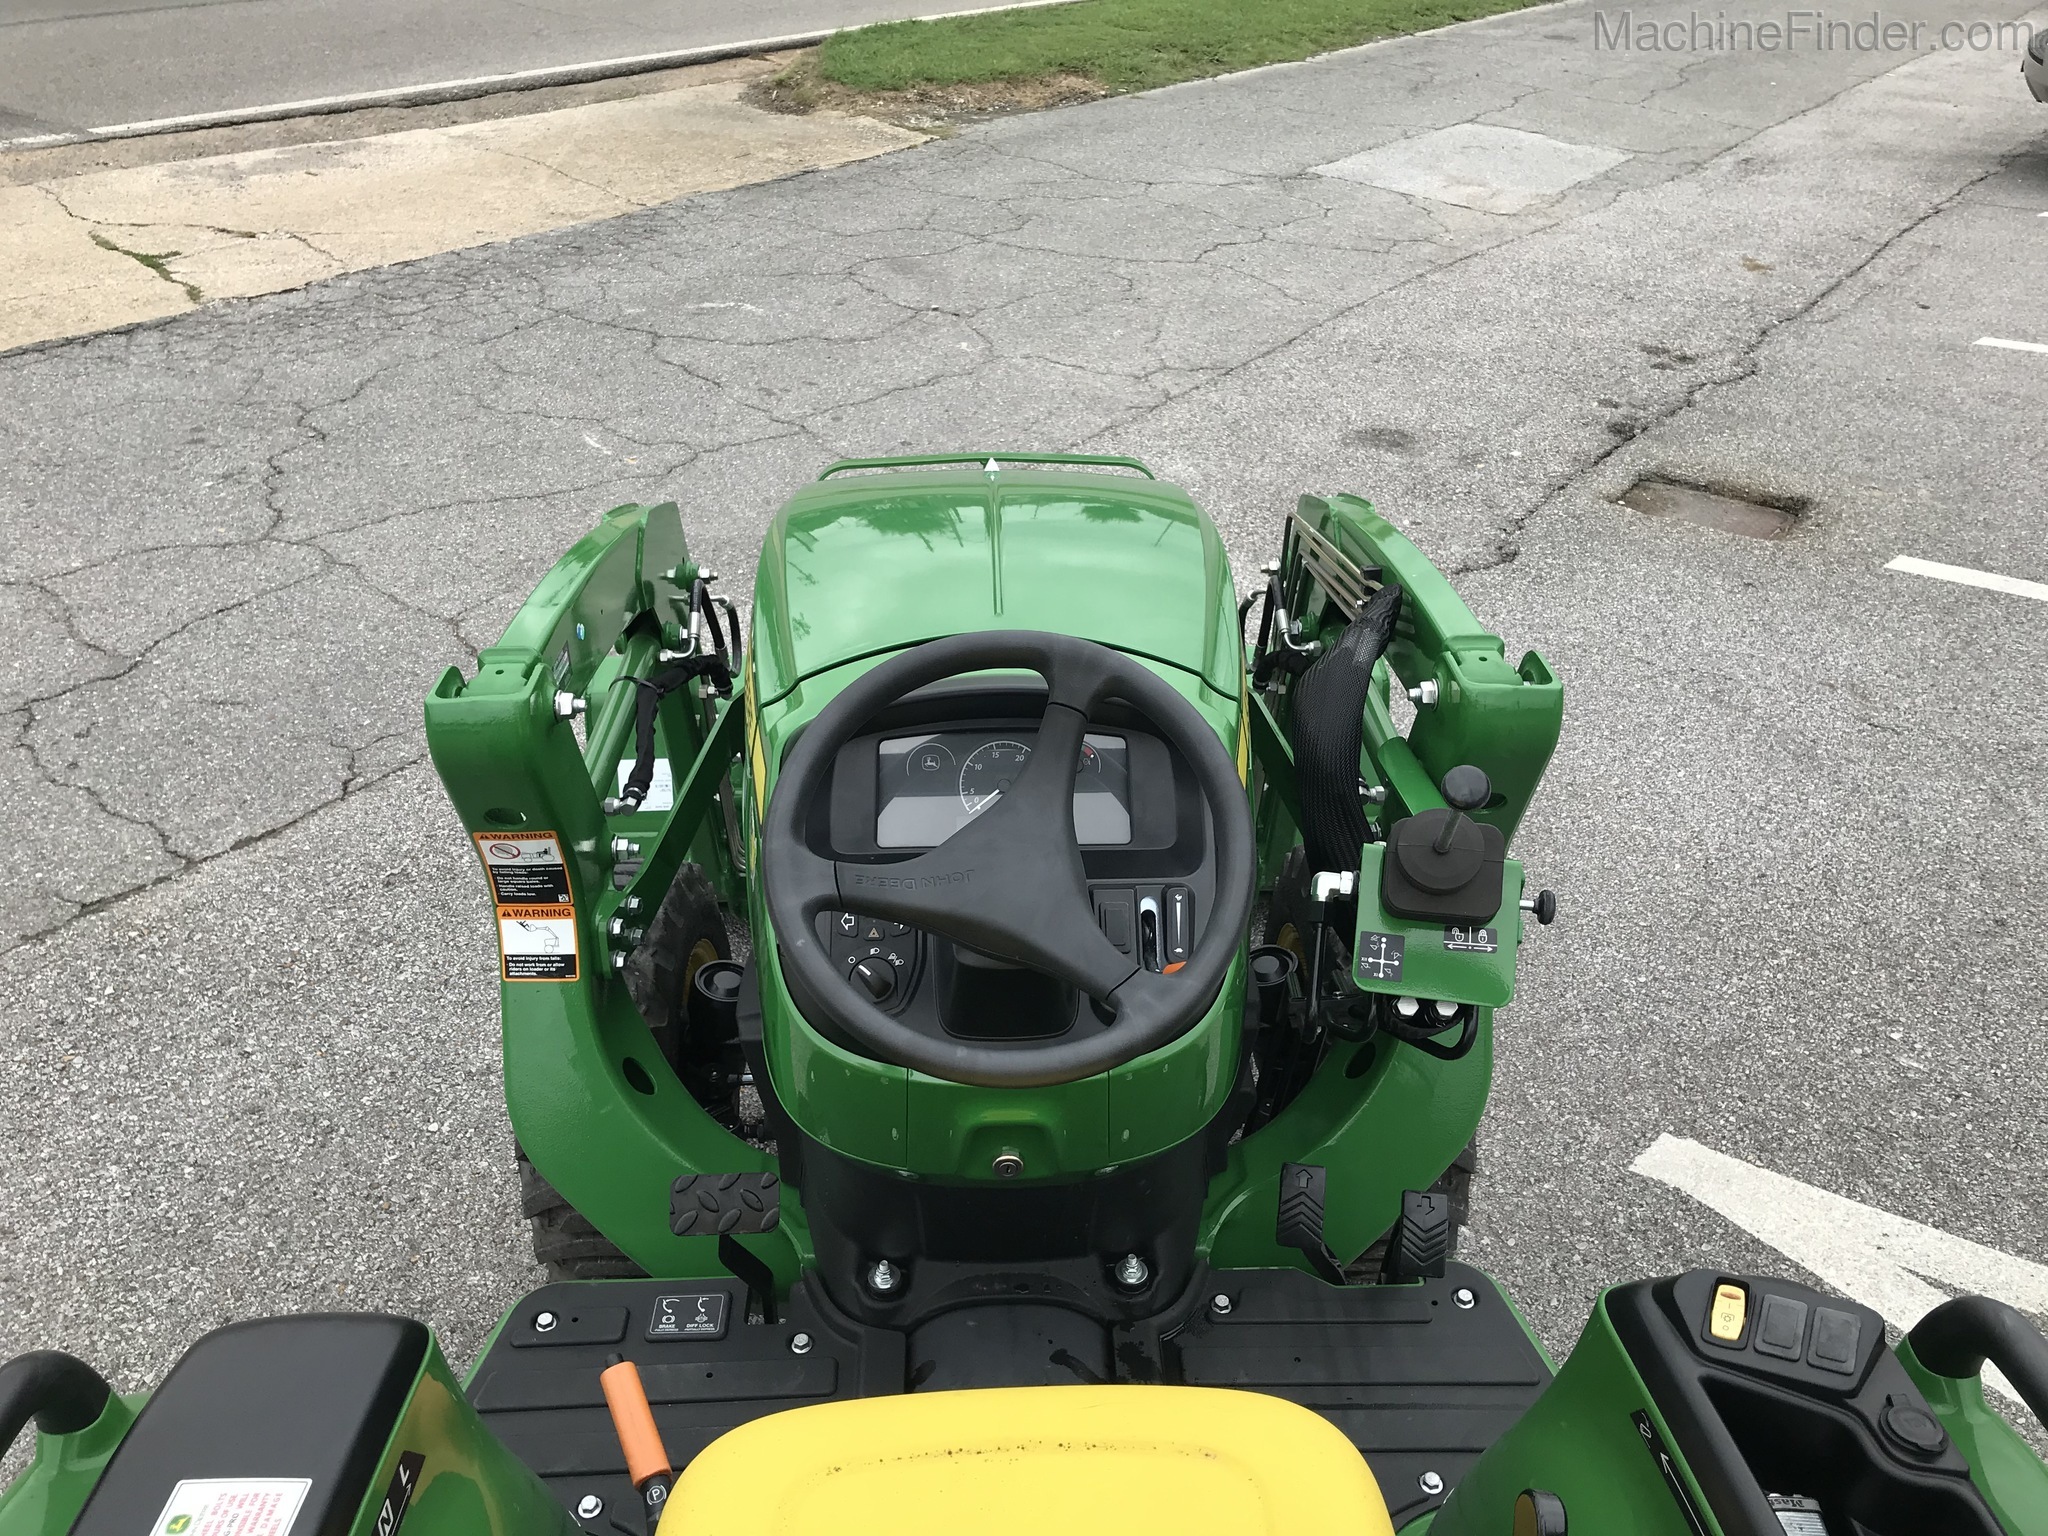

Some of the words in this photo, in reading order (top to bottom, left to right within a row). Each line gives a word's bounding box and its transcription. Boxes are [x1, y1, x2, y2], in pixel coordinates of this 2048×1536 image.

[992, 751, 1000, 759] 15
[1015, 754, 1025, 762] 20
[974, 763, 983, 771] 10
[969, 787, 975, 795] 5
[973, 796, 980, 804] 0
[489, 832, 553, 840] WARNING
[512, 908, 571, 917] WARNING
[235, 1493, 249, 1508] WILL
[248, 1492, 260, 1506] FOR
[210, 1493, 227, 1515] BOLTS
[220, 1509, 230, 1517] OF
[225, 1493, 238, 1506] USE
[246, 1493, 271, 1533] WARRANTY
[260, 1492, 282, 1528] DAMAGE
